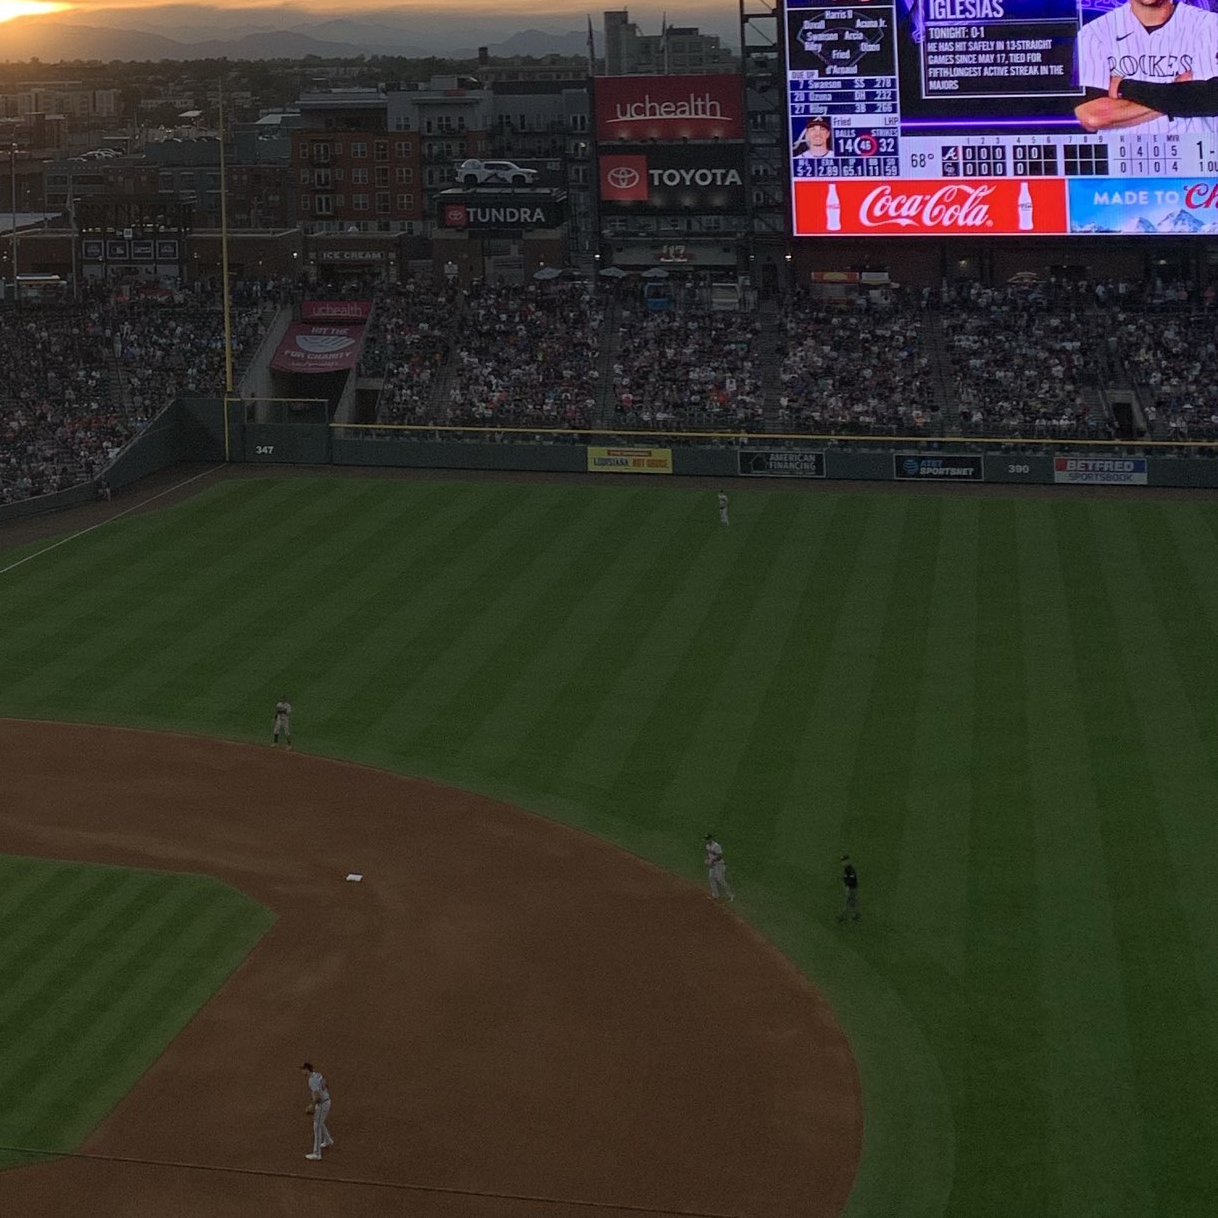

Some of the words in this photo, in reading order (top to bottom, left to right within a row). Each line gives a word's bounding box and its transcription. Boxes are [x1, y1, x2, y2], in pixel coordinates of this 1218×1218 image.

[928, 27, 969, 39] TONIGHT:
[971, 26, 985, 38] 0-1
[928, 41, 938, 52] HE
[939, 41, 954, 51] HAS
[955, 40, 967, 51] HIT
[968, 40, 995, 51] SAFELY
[996, 40, 1004, 50] IN
[1006, 39, 1052, 50] 13-STRAIGHT
[832, 50, 850, 59] Fried
[928, 54, 954, 65] GAMES
[955, 54, 977, 64] SINCE
[978, 54, 994, 64] MAY
[996, 53, 1009, 64] 17,
[1010, 53, 1025, 63] TIED
[1027, 52, 1042, 62] FOR
[928, 66, 982, 77] FIFTH-LONGEST
[983, 66, 1009, 76] ACTIVE
[1010, 65, 1040, 76] STREAK
[1041, 65, 1049, 75] IN
[1050, 65, 1064, 75] THE
[799, 81, 804, 89] 7
[808, 80, 842, 89] Swanson
[854, 79, 865, 88] SS
[929, 80, 959, 90] MAJORS
[616, 93, 721, 119] uchealth
[794, 105, 805, 114] 27
[833, 118, 851, 126] Fried
[884, 117, 899, 125] LHP
[835, 130, 856, 138] BALLS
[871, 129, 899, 137] STRIKES
[838, 139, 853, 152] 14
[879, 138, 895, 152] 32
[966, 147, 972, 159] 0
[981, 147, 987, 159] 0
[996, 147, 1002, 159] 0
[1016, 147, 1022, 159] 0
[1032, 147, 1038, 159] 0
[1119, 146, 1126, 157] 0
[1137, 146, 1143, 157] 4
[1153, 146, 1159, 157] 0
[1171, 146, 1177, 156] 5
[1196, 141, 1203, 159] 1
[911, 153, 934, 168] 68°
[797, 166, 812, 177] 5-2
[818, 166, 838, 177] 2.89
[843, 166, 862, 177] 65.1
[869, 166, 879, 177] 11
[885, 166, 897, 177] 59
[967, 163, 973, 175] 0
[982, 163, 988, 175] 0
[997, 163, 1003, 175] 0
[1018, 163, 1023, 174] 0
[1120, 162, 1126, 173] 0
[1139, 162, 1143, 173] 1
[1154, 162, 1160, 172] 0
[1172, 161, 1178, 172] 4
[1199, 161, 1203, 172] 1
[649, 168, 743, 186] TOYOTA
[1093, 191, 1149, 205] MADE
[1154, 191, 1179, 205] TO
[859, 185, 997, 226] Coca-Cola
[466, 207, 546, 222] TUNDRA
[323, 251, 341, 259] ICE
[343, 251, 382, 259] CREAM
[312, 303, 362, 317] uchealth
[256, 446, 274, 454] 347
[769, 453, 815, 461] AMERICAN
[769, 462, 816, 470] FINANCING
[1008, 464, 1030, 473] 390
[1067, 459, 1134, 471] BETFRED
[920, 467, 974, 476] SPORTSNET
[1068, 472, 1133, 482] SPORTSBOOK
